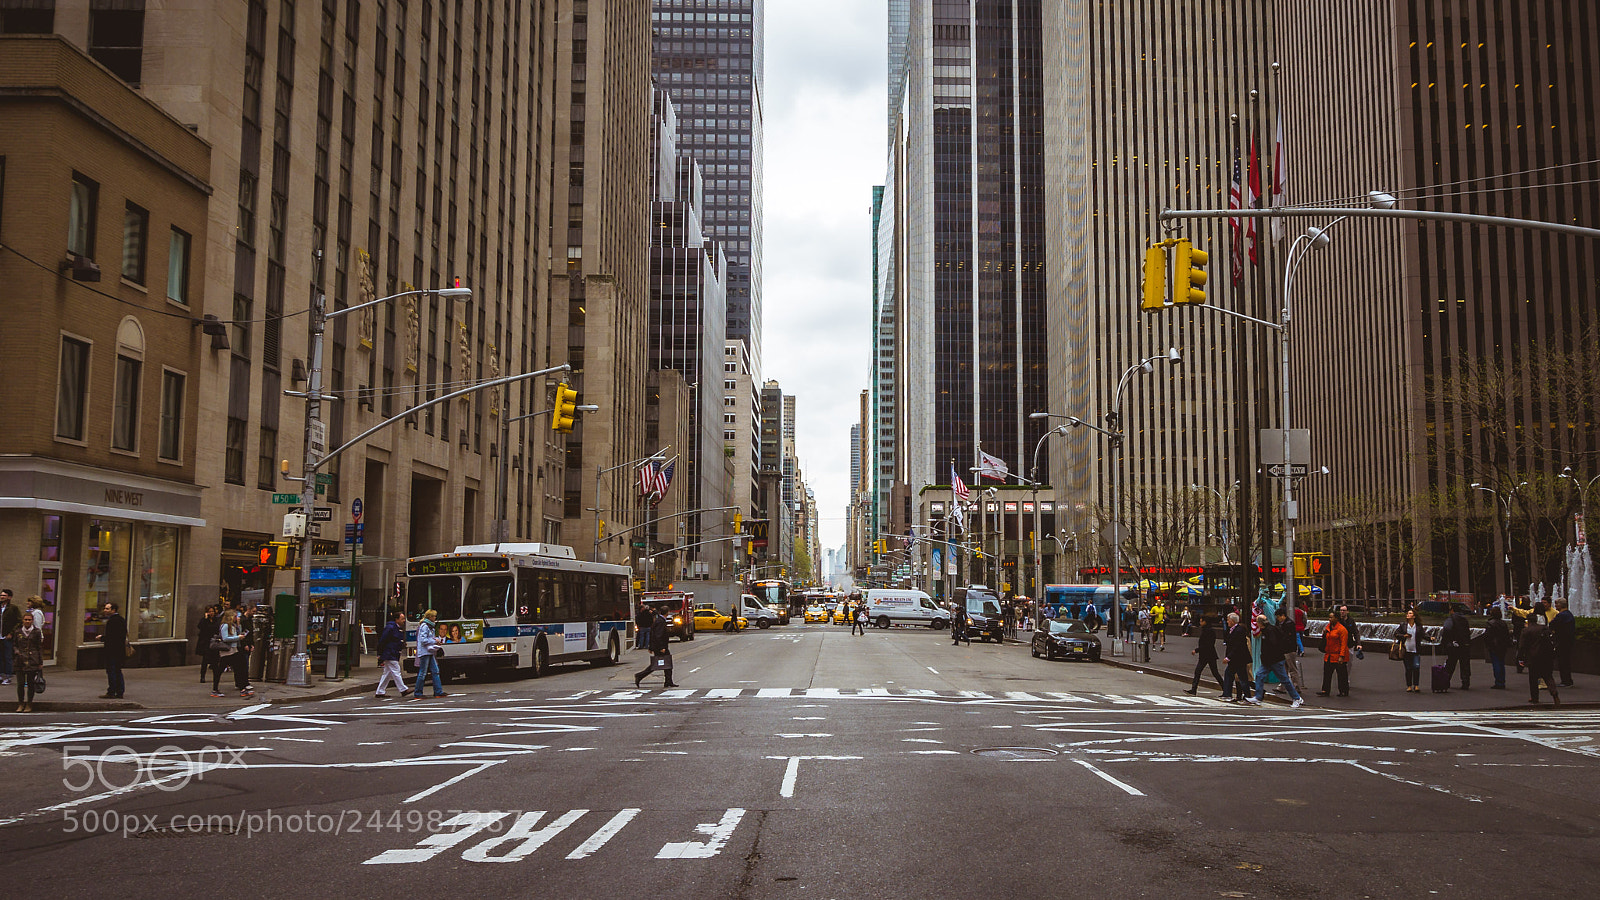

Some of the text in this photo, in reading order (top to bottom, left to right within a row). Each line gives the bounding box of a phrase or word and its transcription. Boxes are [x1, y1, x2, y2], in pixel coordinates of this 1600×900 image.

[104, 488, 144, 506] NINE WEST
[274, 494, 280, 503] W
[280, 494, 289, 503] 50
[423, 562, 436, 573] M5
[361, 807, 747, 865] FIRE
